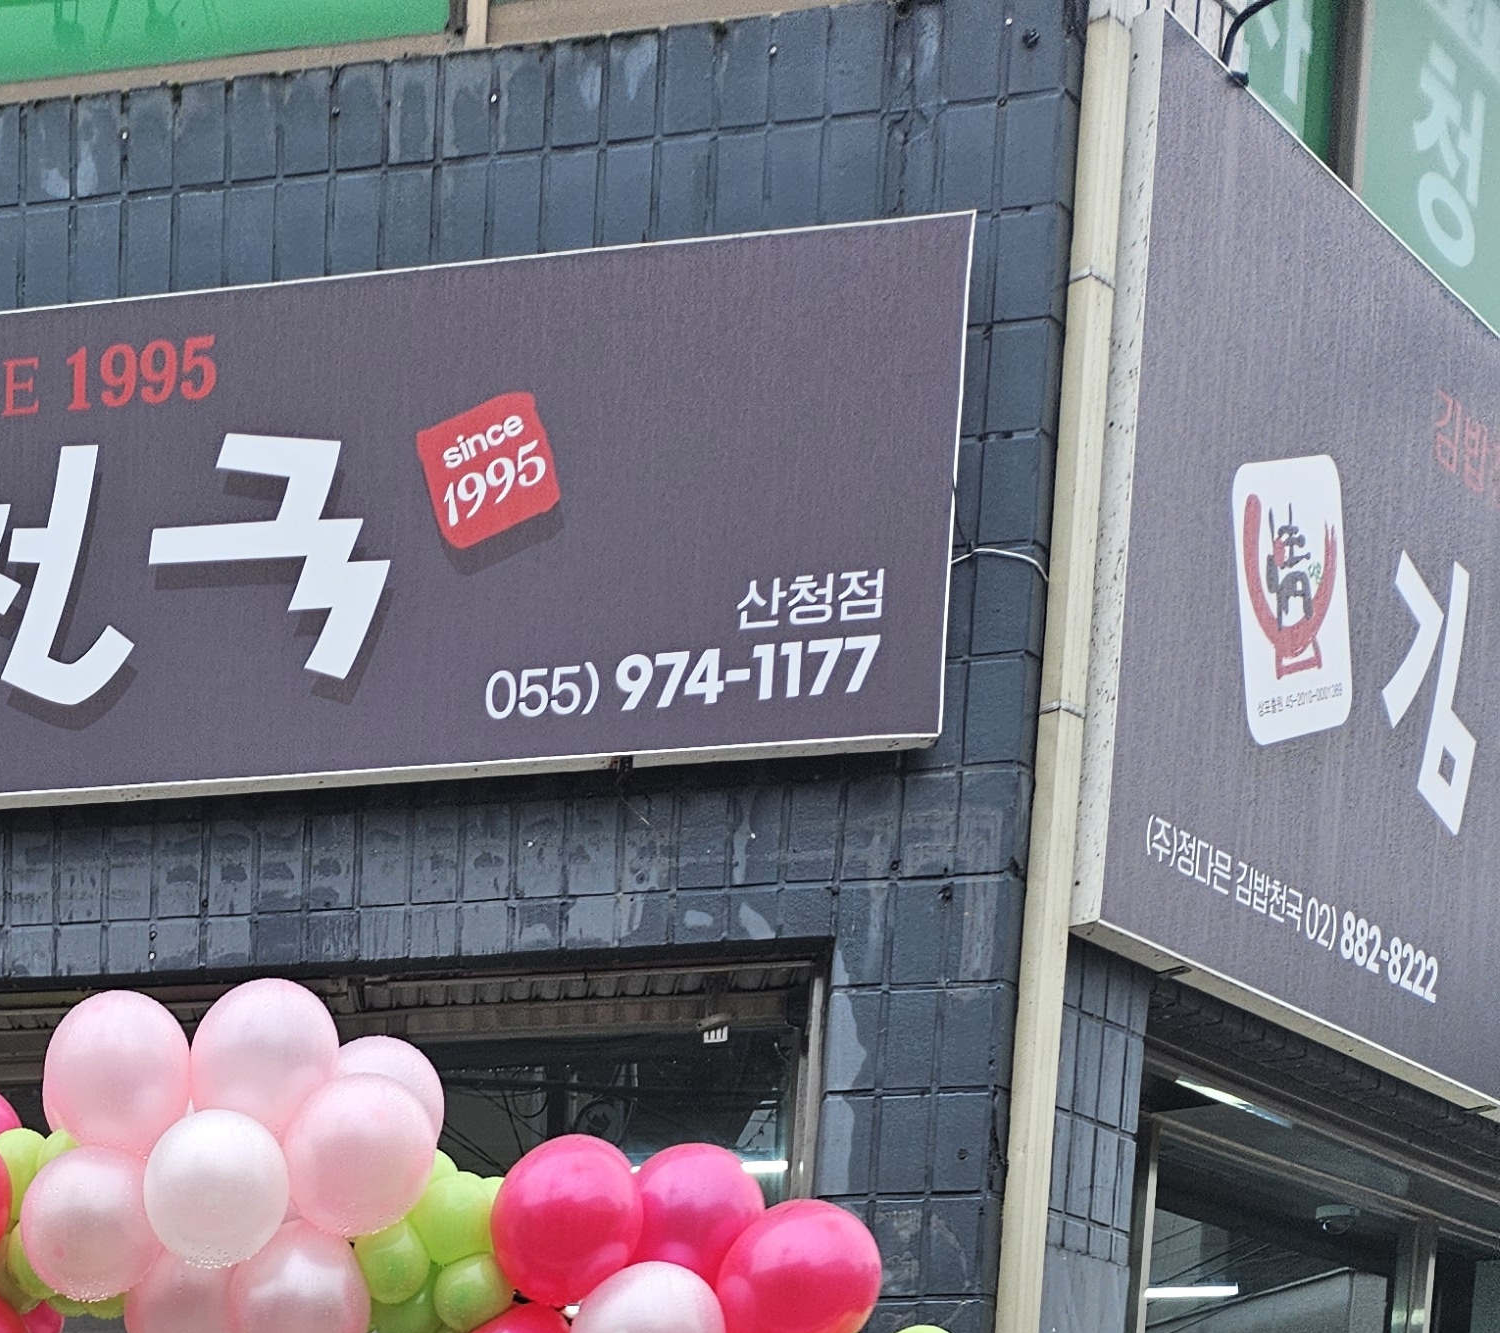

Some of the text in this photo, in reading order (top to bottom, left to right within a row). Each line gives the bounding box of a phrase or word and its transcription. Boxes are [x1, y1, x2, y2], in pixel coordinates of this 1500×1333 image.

[66, 334, 217, 411] 1995
[443, 415, 524, 468] since
[443, 439, 546, 527] 1995
[736, 568, 886, 630] 산청점
[484, 634, 882, 720] 055) 974-1177
[1381, 549, 1477, 836] 김
[1236, 861, 1303, 932] 김밥천국
[1305, 896, 1338, 951] 02)
[1340, 910, 1439, 1004] 882-8222
